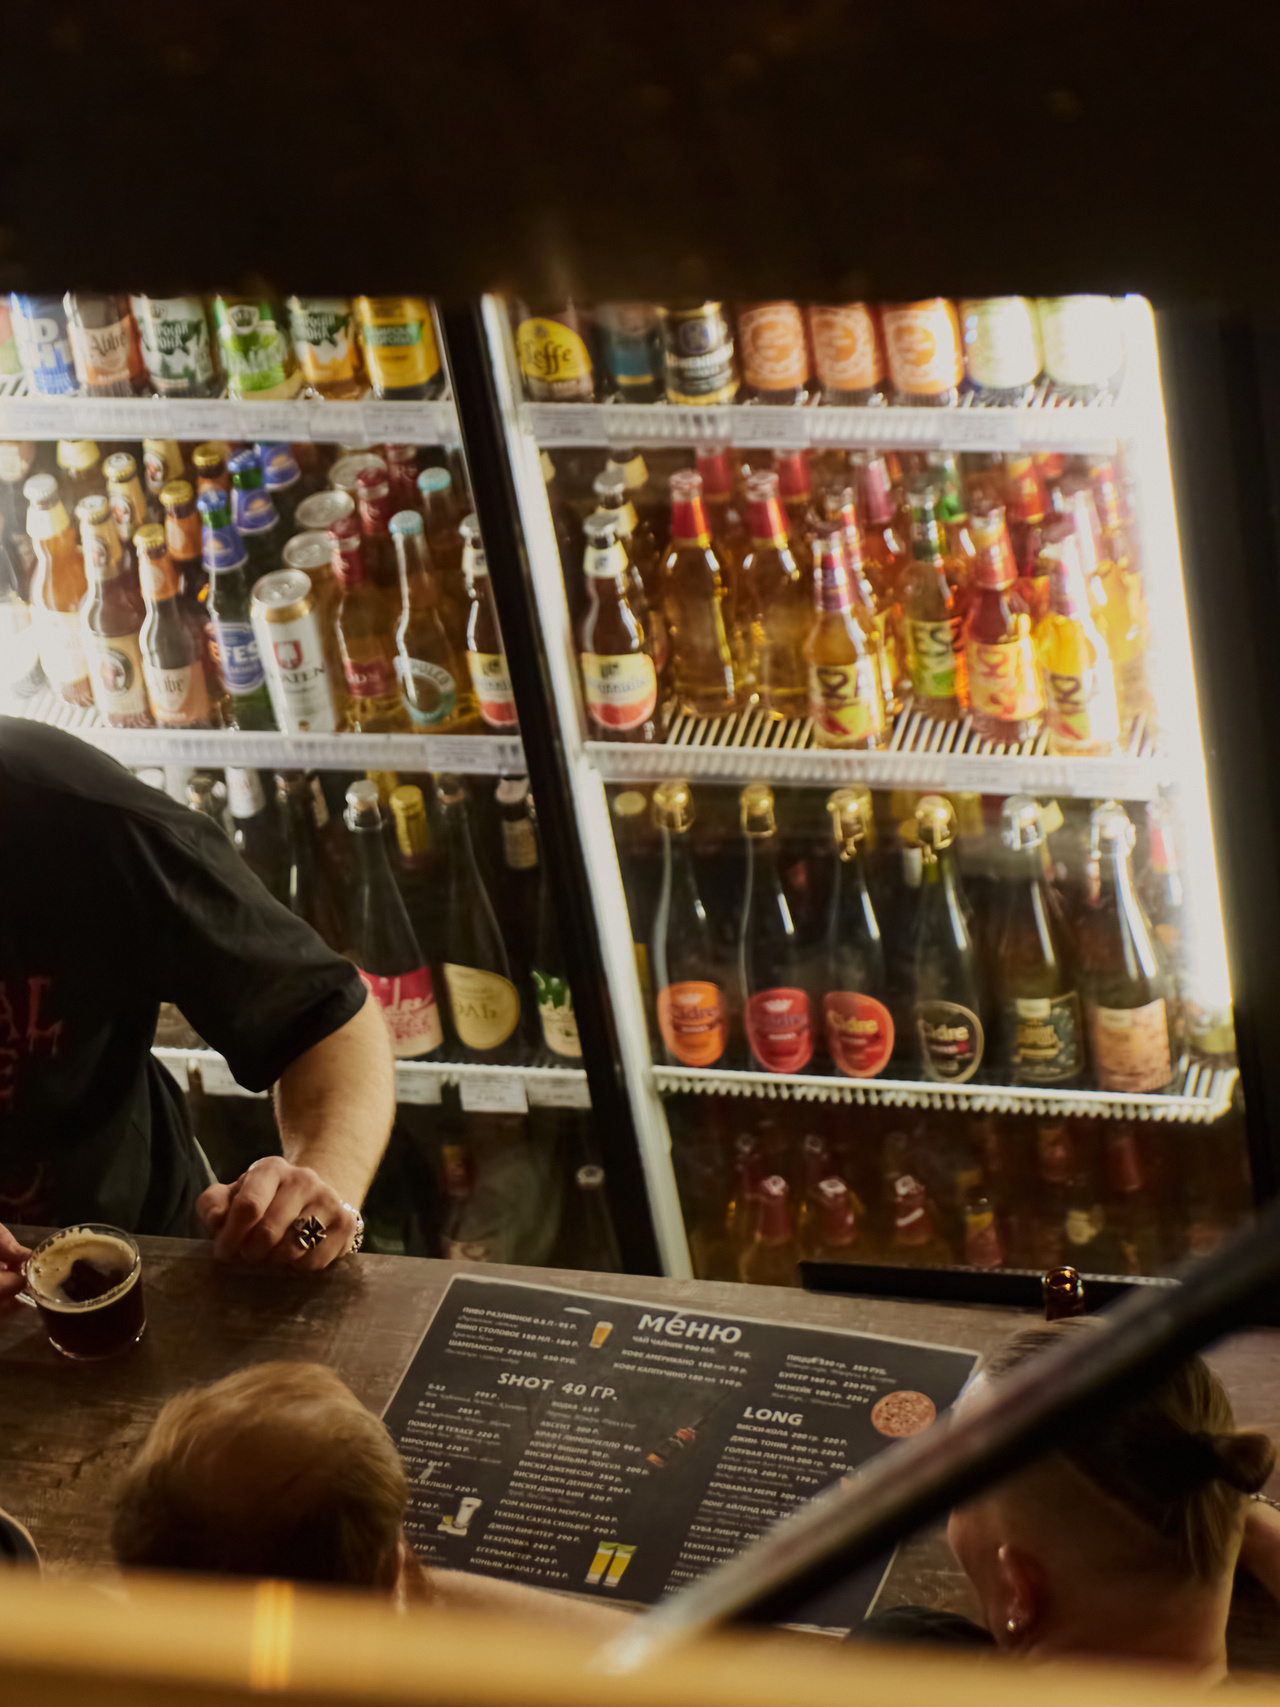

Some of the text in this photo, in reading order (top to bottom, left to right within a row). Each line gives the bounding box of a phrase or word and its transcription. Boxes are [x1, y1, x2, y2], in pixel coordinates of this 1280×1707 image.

[463, 1307, 485, 1315] ПИВО
[486, 1311, 532, 1322] РАЗЛИВНОЕ
[479, 1327, 519, 1337] СТОЛОВОЕ
[632, 1335, 650, 1343] ЧАЙ
[449, 1340, 503, 1352] ШАМПАНСКОЕ
[645, 1353, 695, 1365] АМЕРИКАНО
[613, 1363, 636, 1371] КОФЕ
[637, 1366, 687, 1378] КАППУЧИНО
[779, 1371, 808, 1380] БУРГЕР
[497, 1372, 620, 1401] SHOT 40 ГР.
[774, 1384, 812, 1393] ЧИЗКЕЙК
[743, 1406, 804, 1425] LONG
[408, 1420, 437, 1429] ПОЖАР
[445, 1426, 474, 1435] ТЕХАСЕ
[540, 1421, 570, 1430] АБСЕНТ
[736, 1423, 788, 1436] ВИСКИ-КОЛА
[530, 1441, 556, 1449] КРАФТ
[535, 1430, 561, 1439] КРАФТ
[563, 1435, 620, 1448] ЛИМОНЧЕЛЛО
[761, 1440, 788, 1448] ТОНИК
[525, 1450, 551, 1458] ВИСКИ
[553, 1455, 587, 1464] ВИЛЬЯМ
[589, 1460, 621, 1469] ЛОУСЕН
[725, 1447, 761, 1457] ГОЛУБАЯ
[763, 1453, 795, 1462] ЛАГУНА
[519, 1461, 546, 1469] ВИСКИ
[547, 1466, 593, 1477] ДЖЕМЕСОН
[717, 1463, 758, 1473] ОТВЕРТКА
[513, 1471, 541, 1479] ВИСКИ
[421, 1480, 452, 1489] ВУЛКАН
[509, 1482, 536, 1490] ВИСКИ
[709, 1482, 752, 1493] КРОВАВАЯ
[754, 1489, 776, 1497] МЕРИ
[520, 1503, 557, 1512] КАПИТАН
[558, 1509, 591, 1518] МОРГАН
[702, 1499, 723, 1507] ЛОНГ
[726, 1503, 760, 1513] АЙЛЕНД
[494, 1511, 524, 1519] ТЕКИЛА
[553, 1520, 590, 1530] СИЛЬВЕР
[489, 1523, 514, 1531] ДЖИН
[713, 1528, 740, 1536] ЛИБРЕ
[483, 1534, 530, 1545] БЕХЕРОВКА
[684, 1541, 714, 1550] ТЕКИЛА
[476, 1547, 531, 1559] ЕГЕРЬМАСТЕР
[679, 1552, 711, 1561] ТЕКИЛА
[470, 1558, 503, 1567] КОНЬЯК
[505, 1563, 534, 1572] АРАРАТ
